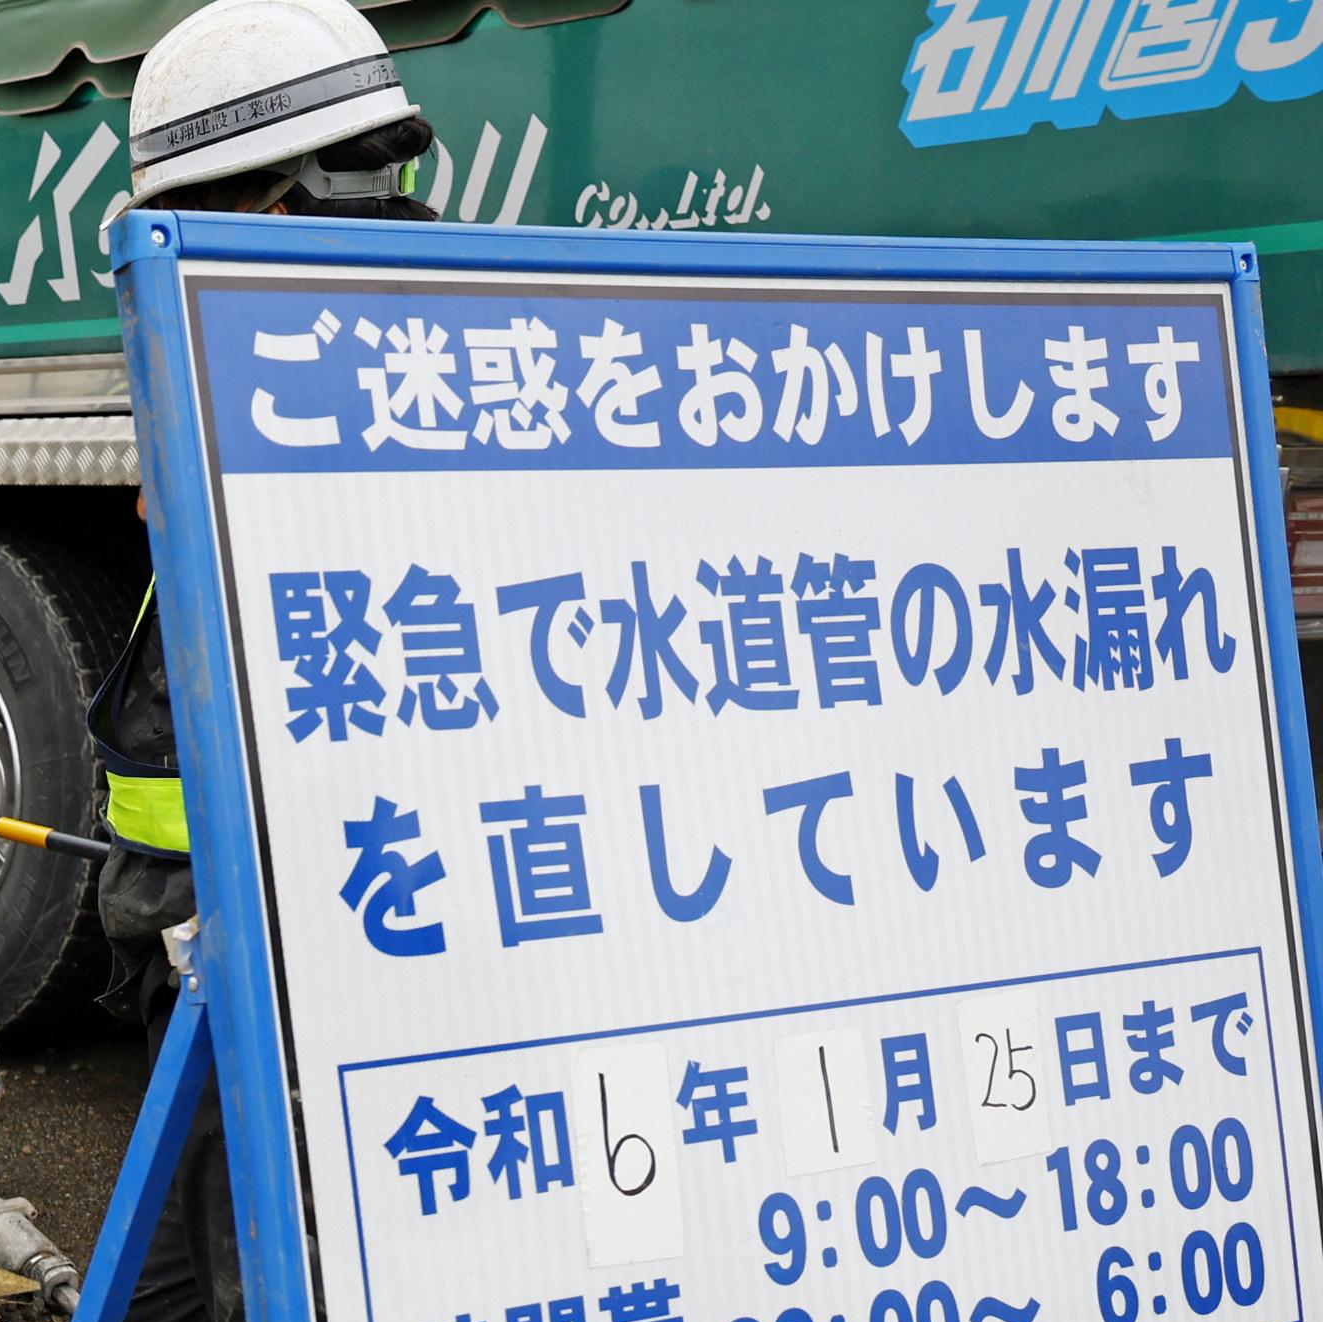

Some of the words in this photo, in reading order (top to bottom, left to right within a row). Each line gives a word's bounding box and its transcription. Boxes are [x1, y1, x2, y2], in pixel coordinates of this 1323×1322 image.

[251, 308, 1200, 452] ご迷惑をおかけします
[269, 548, 1235, 743] 緊急で水道管の水漏れ
[340, 738, 1212, 957] を直しています
